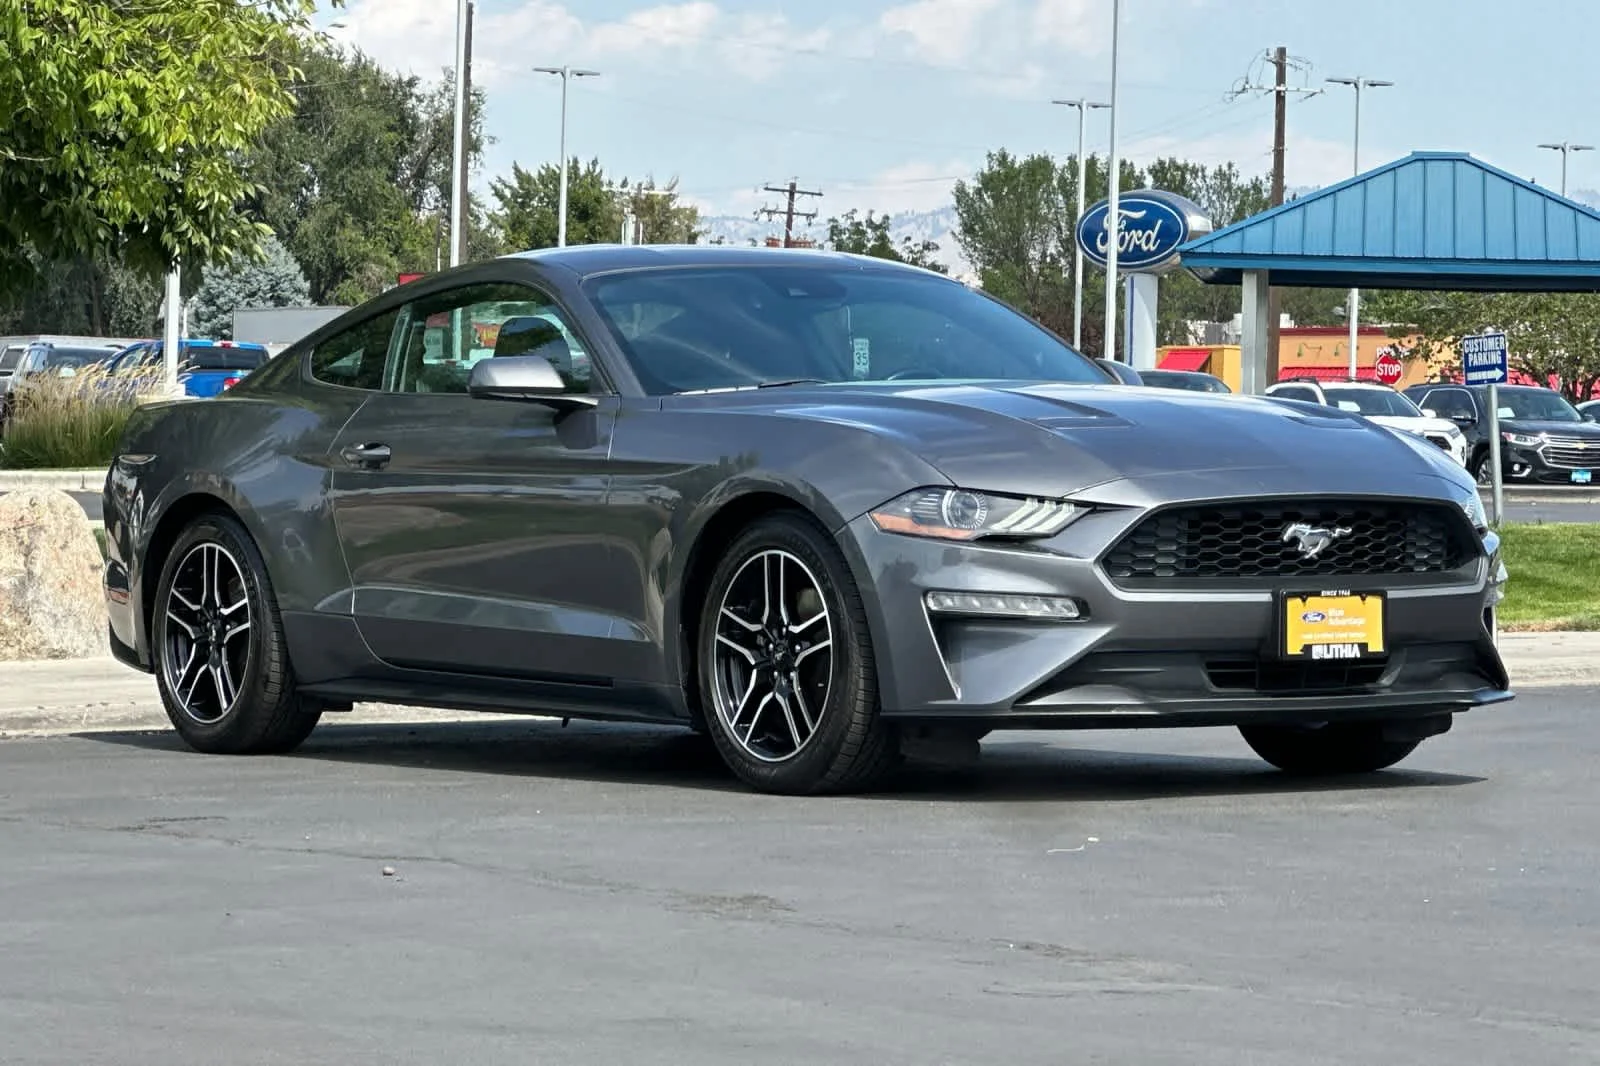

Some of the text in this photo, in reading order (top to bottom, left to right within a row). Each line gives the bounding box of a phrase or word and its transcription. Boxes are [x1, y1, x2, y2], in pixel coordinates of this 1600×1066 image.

[1096, 209, 1163, 253] Ford
[1464, 336, 1505, 353] CUSTOMER
[1468, 350, 1502, 367] PARKING
[1377, 363, 1401, 376] STOP
[1323, 643, 1361, 659] LITHIA
